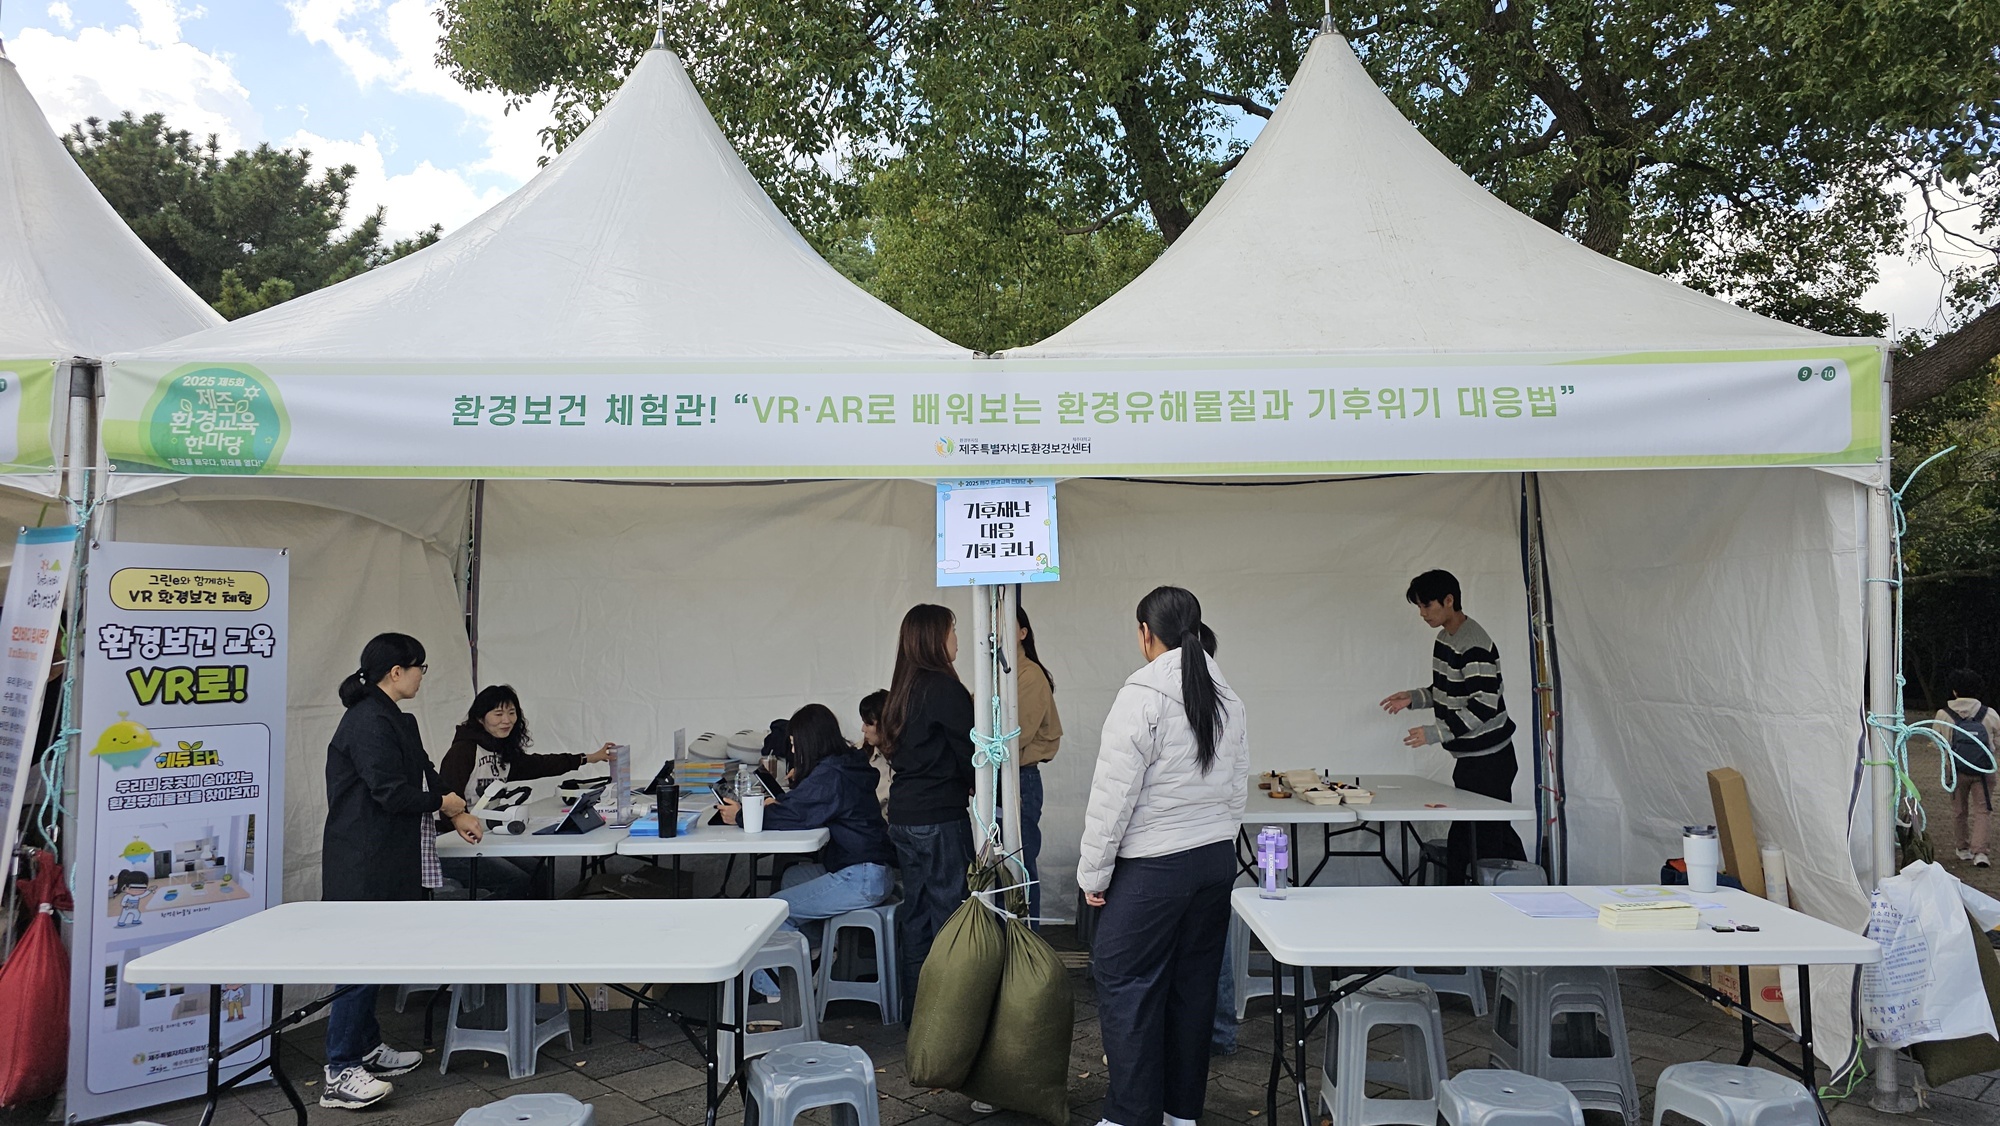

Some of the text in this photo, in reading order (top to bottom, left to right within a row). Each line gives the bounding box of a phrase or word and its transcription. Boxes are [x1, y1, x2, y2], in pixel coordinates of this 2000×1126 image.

[182, 376, 246, 387] 2025 제5회
[1801, 370, 1808, 378] 9
[1823, 369, 1834, 378] 10
[196, 389, 236, 412] 제주
[452, 394, 587, 426] 환경보건
[605, 393, 717, 426] 체험관!
[913, 393, 1042, 425] 배워보는
[1057, 389, 1294, 424] 환경유해물질과
[1308, 386, 1441, 420] 기후위기
[169, 410, 260, 435] 환경교육
[184, 433, 245, 456] 한마당
[958, 442, 1091, 455] 제주특별자치도환경보건센터
[963, 501, 1031, 519] 기후재난
[980, 522, 1015, 539] 대응
[962, 541, 1034, 559] 기획 코너
[149, 575, 235, 587] 그린e와 함께하는
[129, 590, 252, 605] VR 환경보건 체험
[99, 623, 275, 660] 환경보건 교육
[126, 665, 249, 706] VR로!
[116, 771, 253, 793] 우리집 곳곳에 숨어있는
[108, 785, 259, 811] 환경유해물질을 찾아보자!
[147, 1041, 223, 1061] 제주특별자치도환경보
